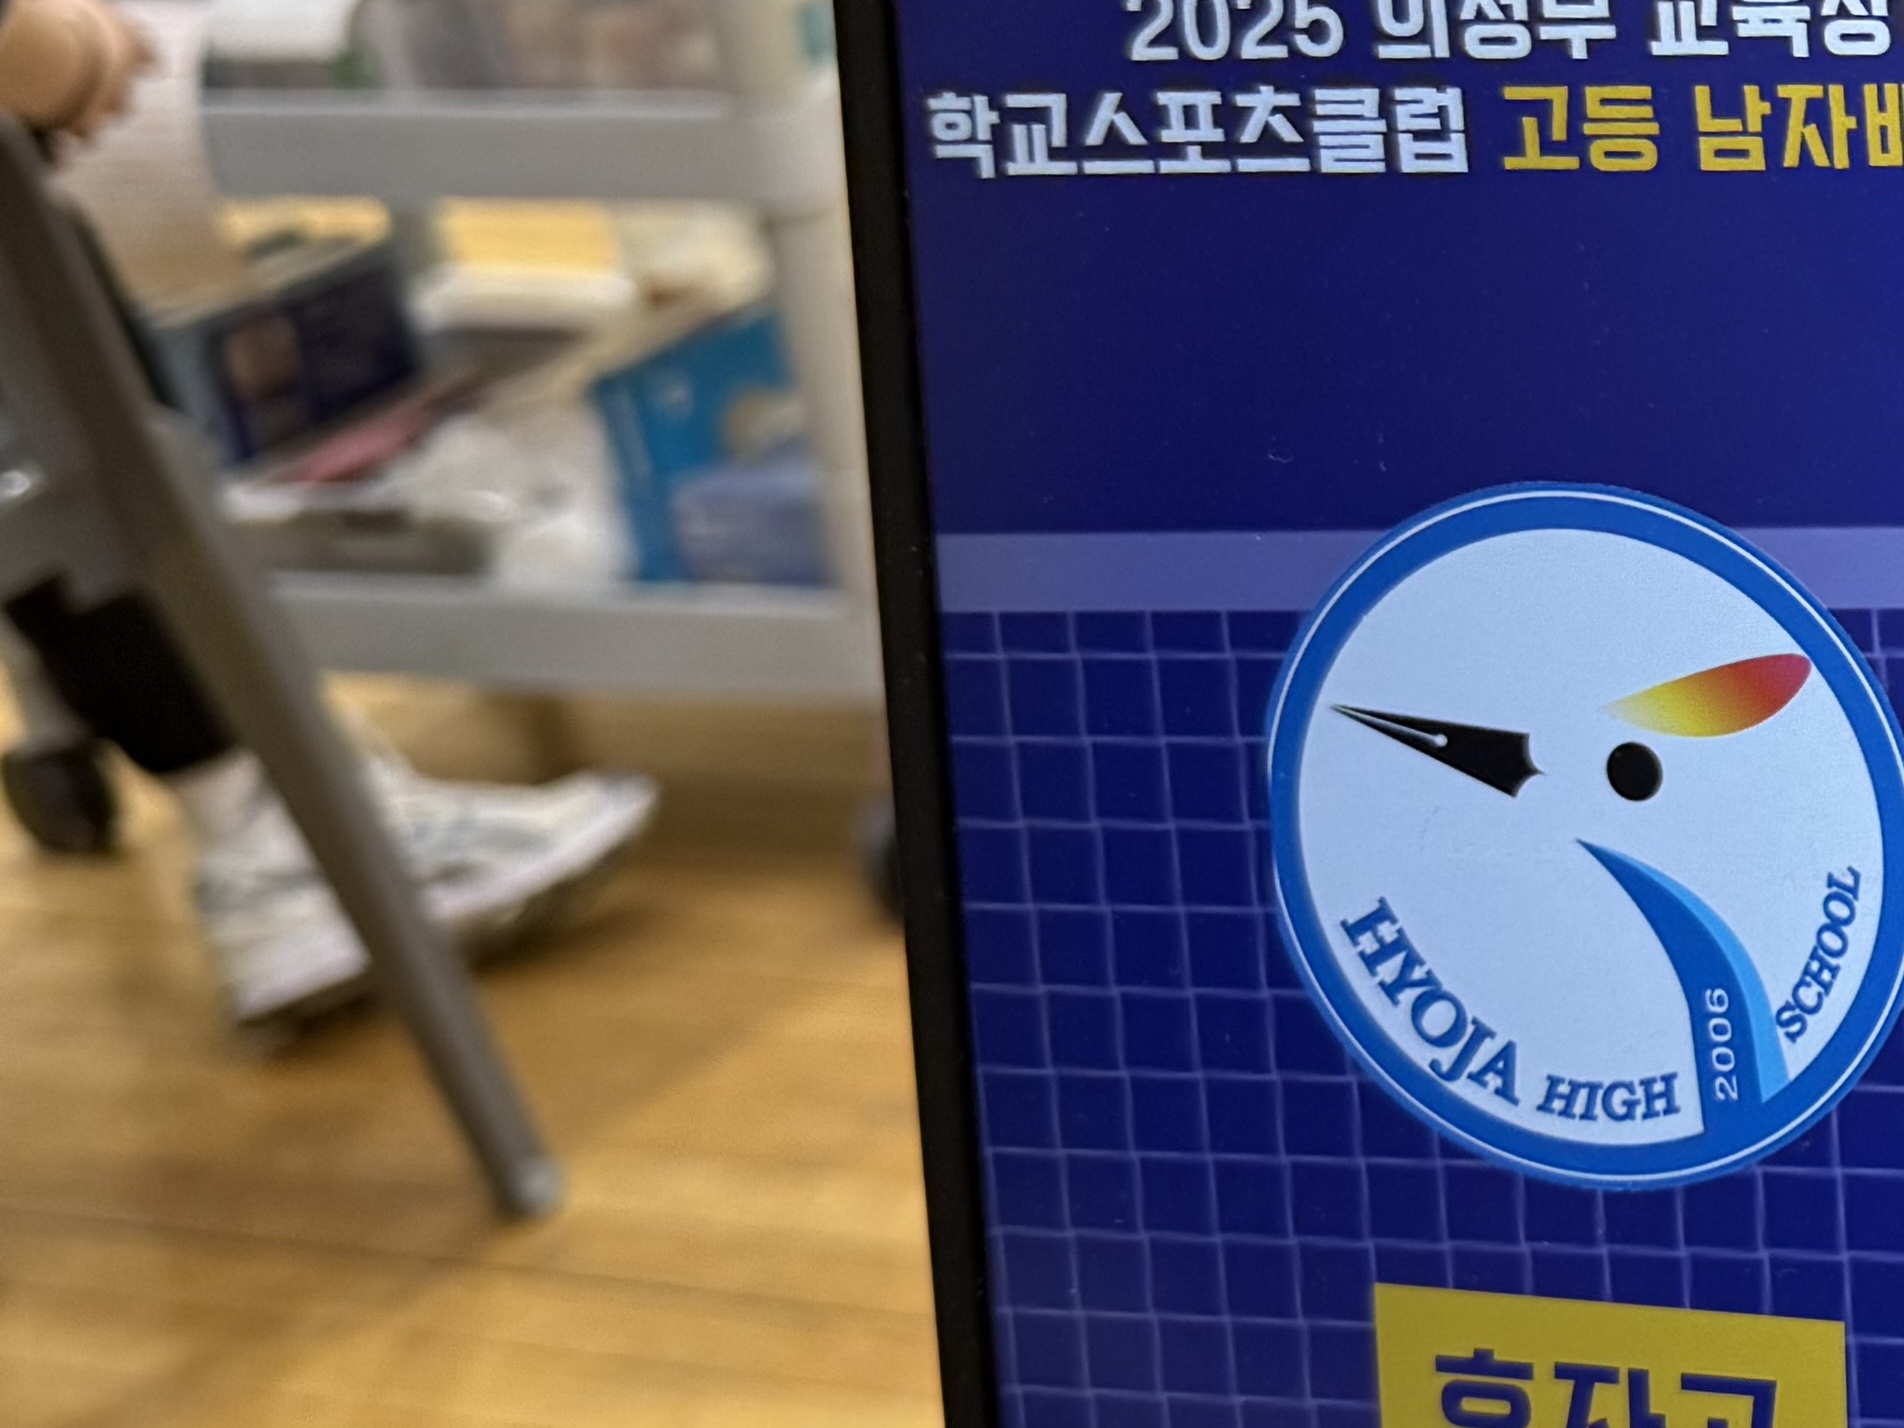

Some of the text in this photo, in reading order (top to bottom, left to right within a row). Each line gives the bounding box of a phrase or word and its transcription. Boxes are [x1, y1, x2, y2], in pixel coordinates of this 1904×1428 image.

[928, 86, 1468, 178] 학교스포츠클럽
[1503, 86, 1660, 172] 고등
[1340, 866, 1862, 1122] HYOJA HIGH SCHOOL
[1704, 988, 1738, 1100] 2006
